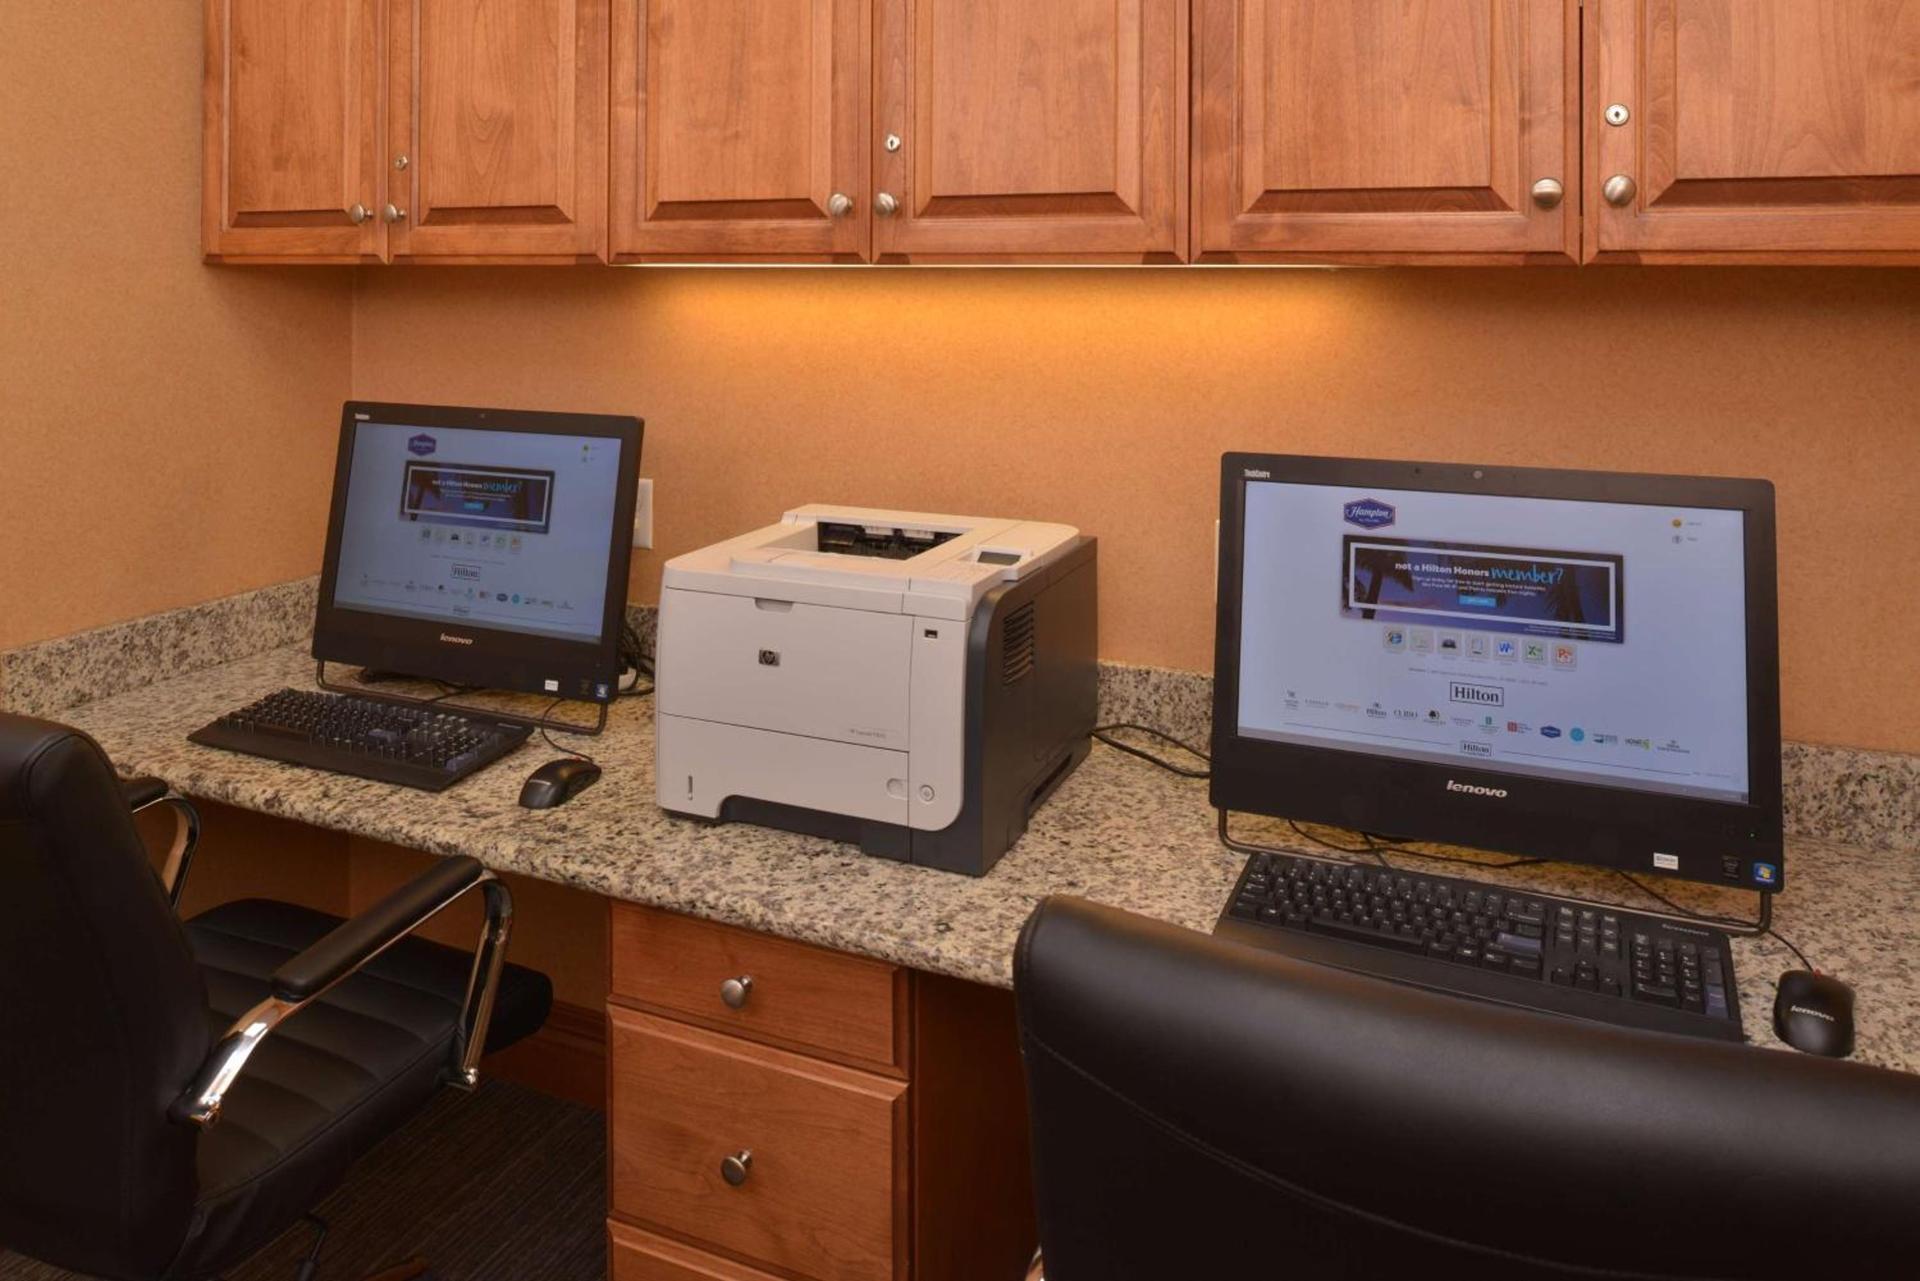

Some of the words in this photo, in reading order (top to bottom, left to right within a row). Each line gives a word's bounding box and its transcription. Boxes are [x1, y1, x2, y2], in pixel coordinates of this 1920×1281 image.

[1347, 505, 1392, 519] Hampton
[1395, 562, 1412, 571] not
[1422, 563, 1451, 574] Hilton
[1453, 566, 1489, 577] Honors
[1490, 565, 1563, 585] member?
[440, 632, 473, 645] lenovo
[1455, 686, 1499, 703] Hilton
[1446, 780, 1508, 798] lenovo
